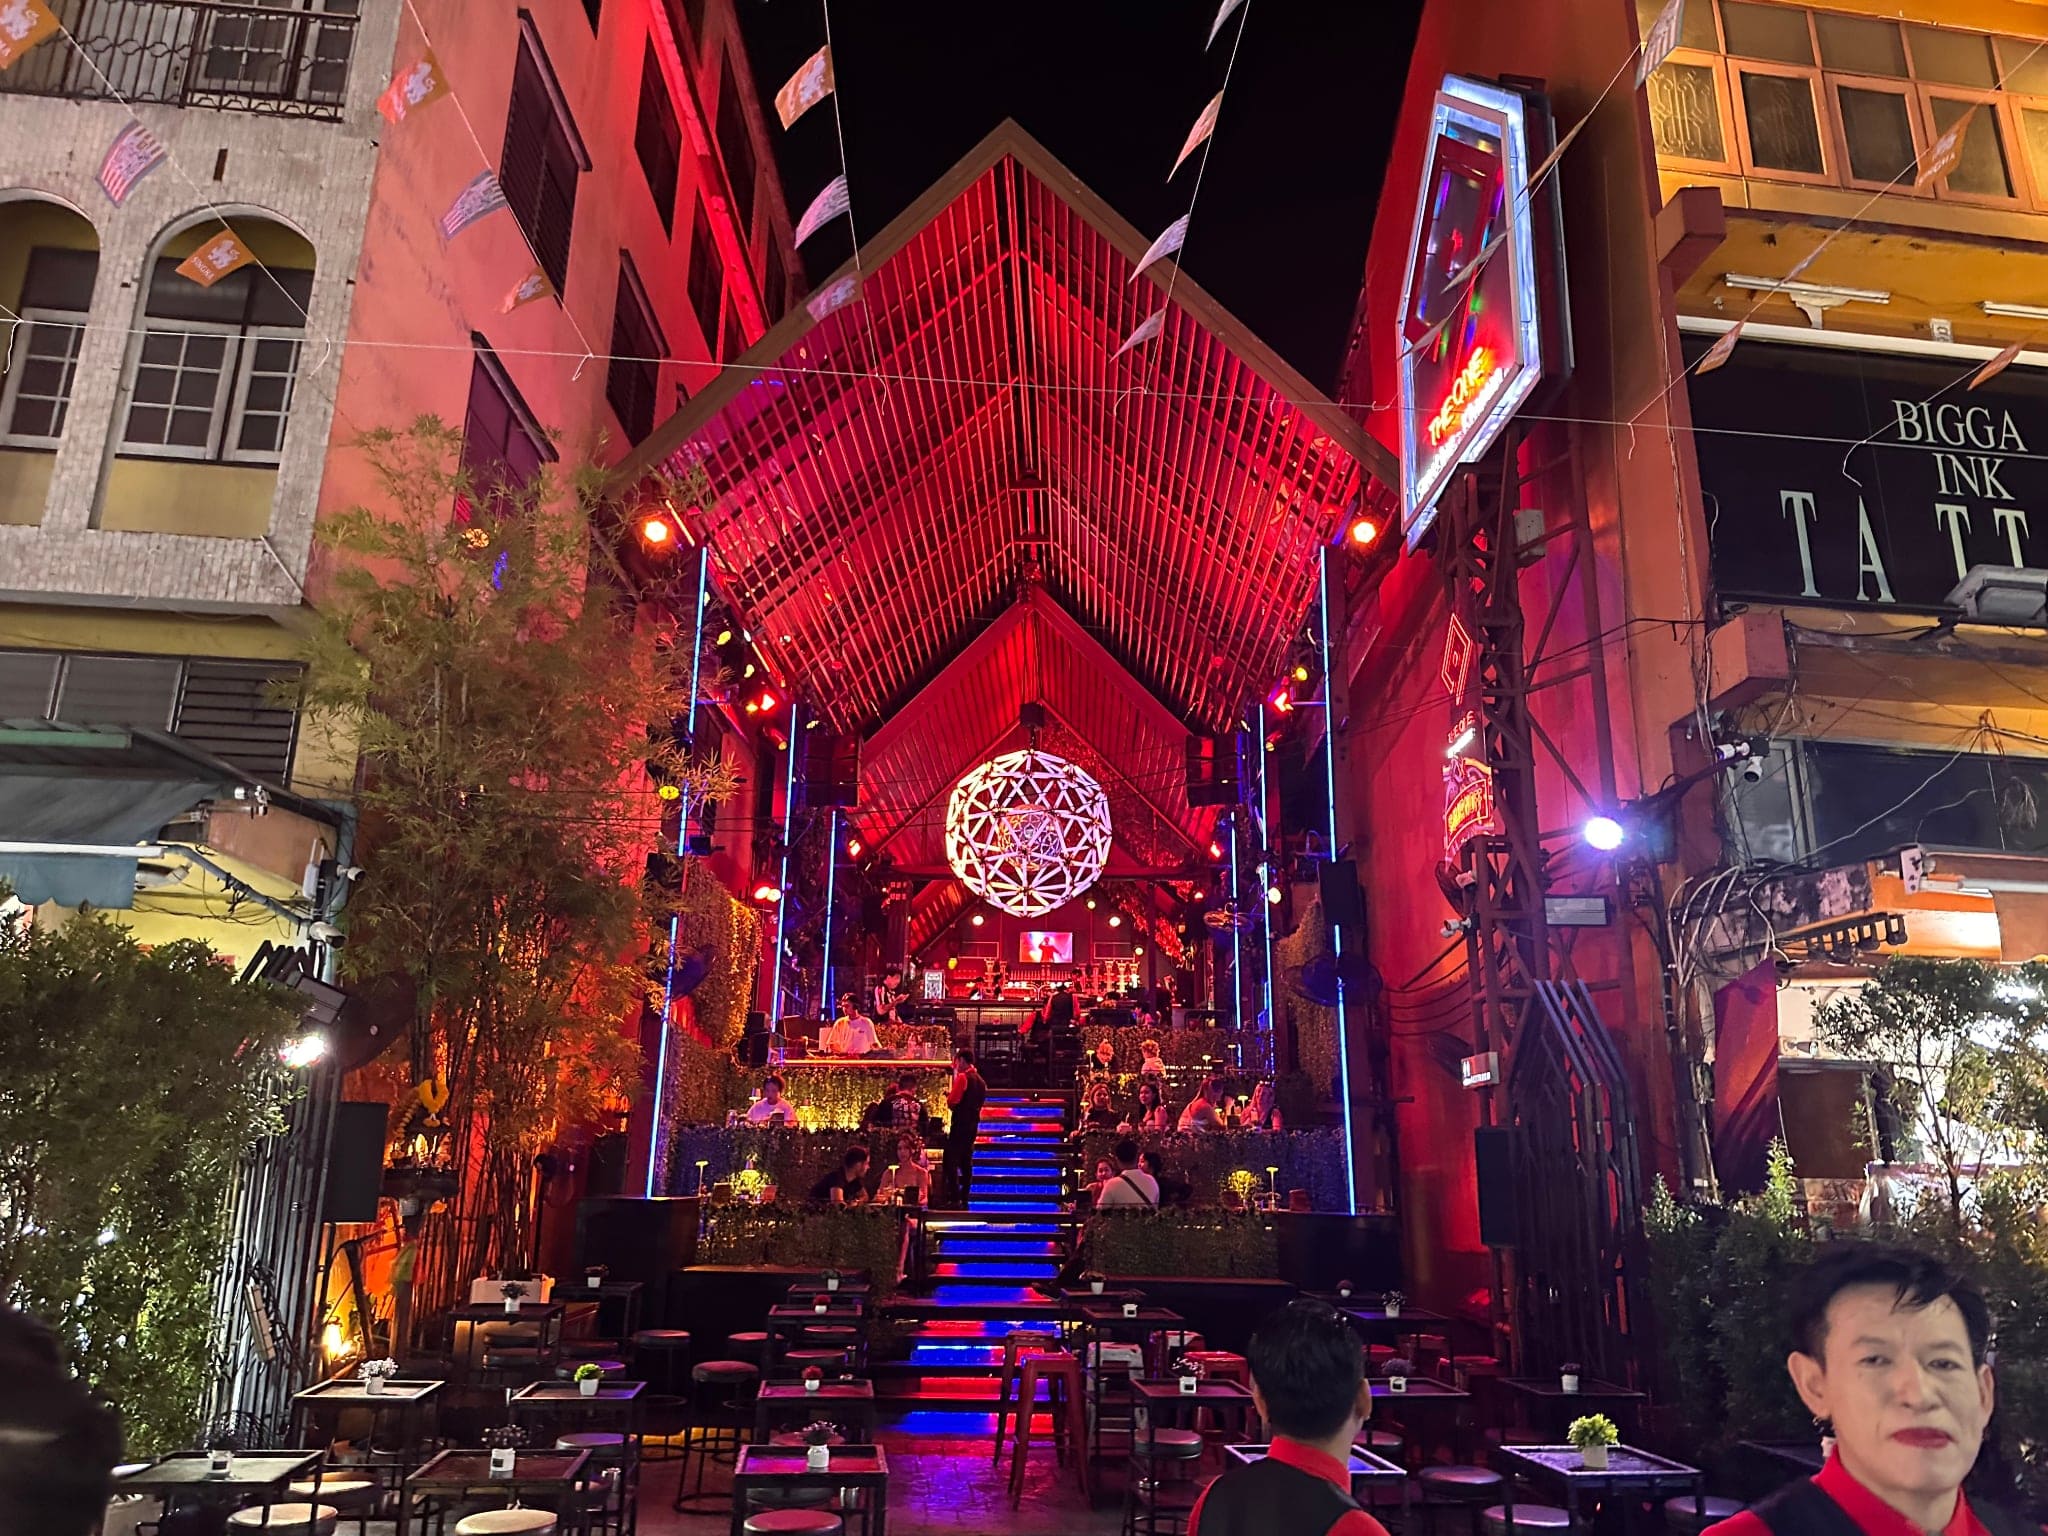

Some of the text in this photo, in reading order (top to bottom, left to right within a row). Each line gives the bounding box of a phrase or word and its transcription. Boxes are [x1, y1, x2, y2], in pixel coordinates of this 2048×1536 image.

[1453, 346, 1484, 405] ONE
[1892, 400, 2029, 452] BIGGA
[1932, 452, 2015, 500] INK
